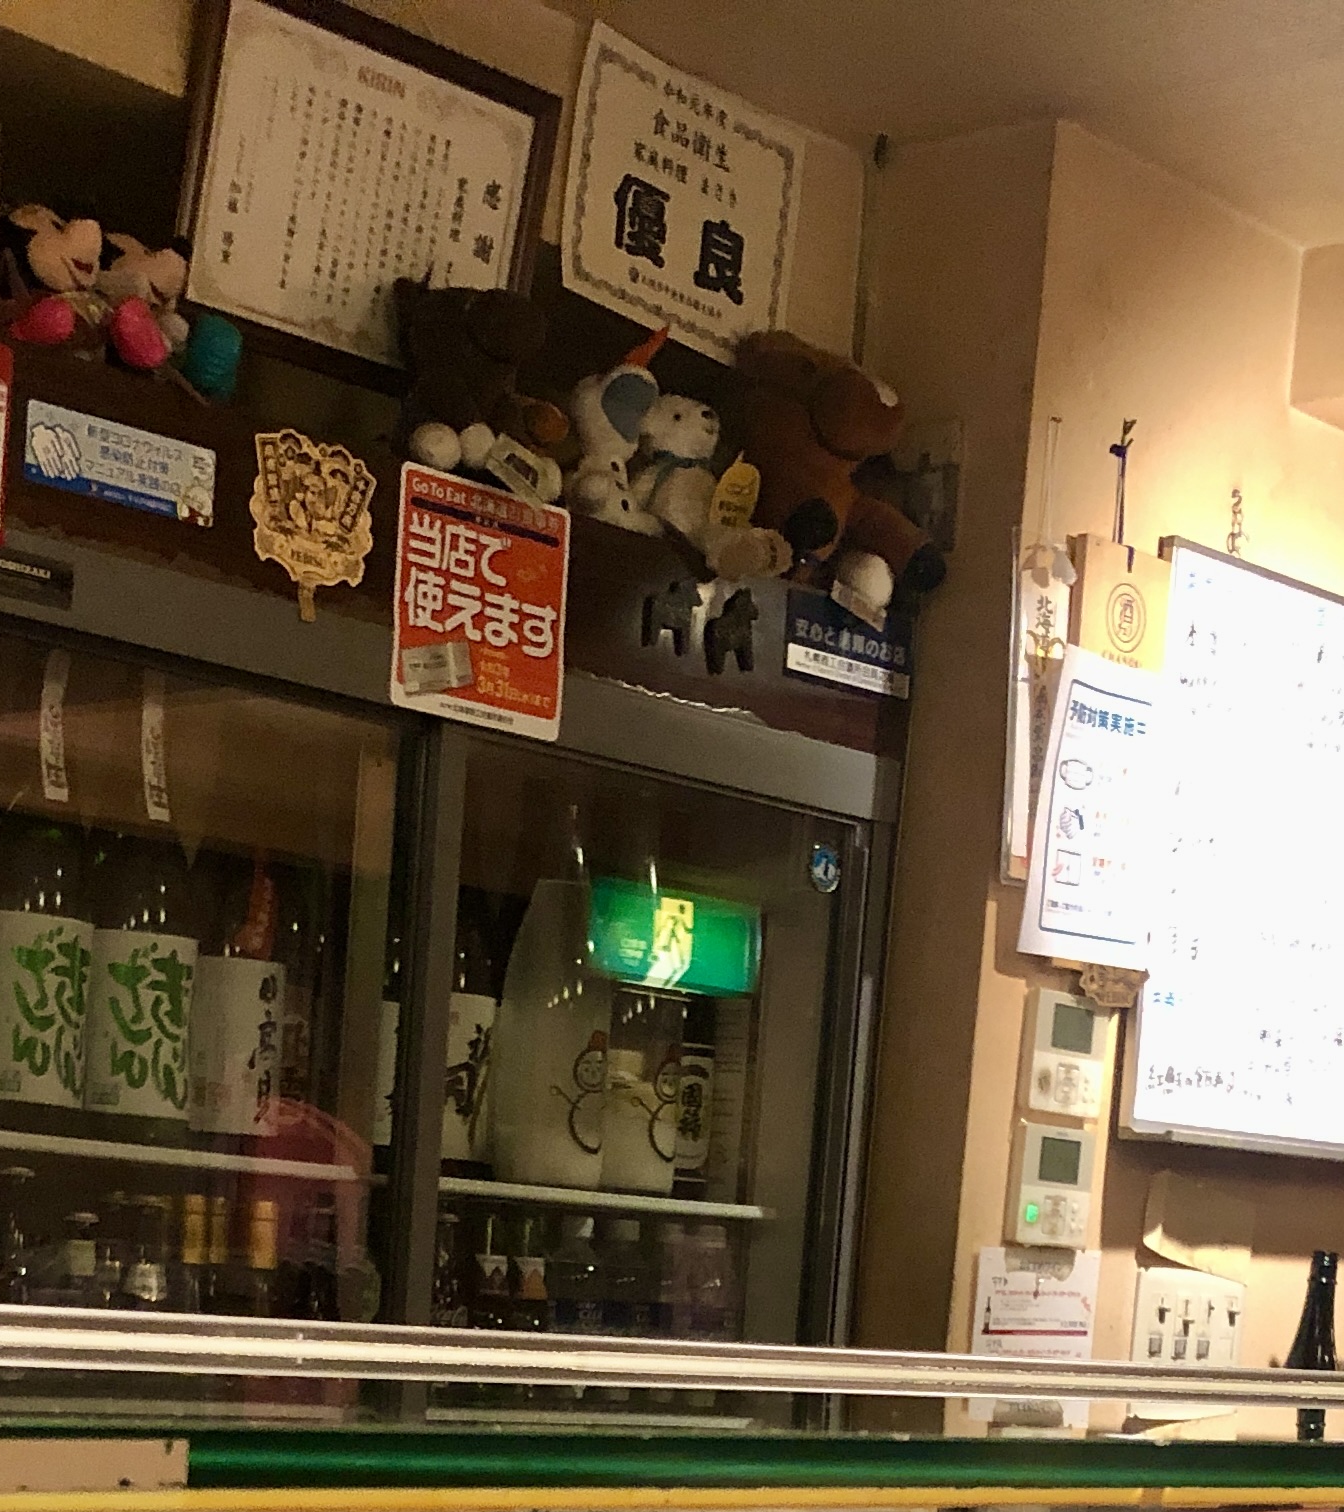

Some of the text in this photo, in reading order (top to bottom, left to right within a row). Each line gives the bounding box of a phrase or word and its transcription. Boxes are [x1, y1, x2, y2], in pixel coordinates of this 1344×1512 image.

[654, 108, 730, 173] 食品衛生
[614, 173, 745, 305] 優良
[412, 476, 430, 494] Go
[430, 481, 445, 498] To
[445, 486, 467, 505] Eat
[406, 511, 512, 587] 当店で
[403, 566, 556, 660] 使えます
